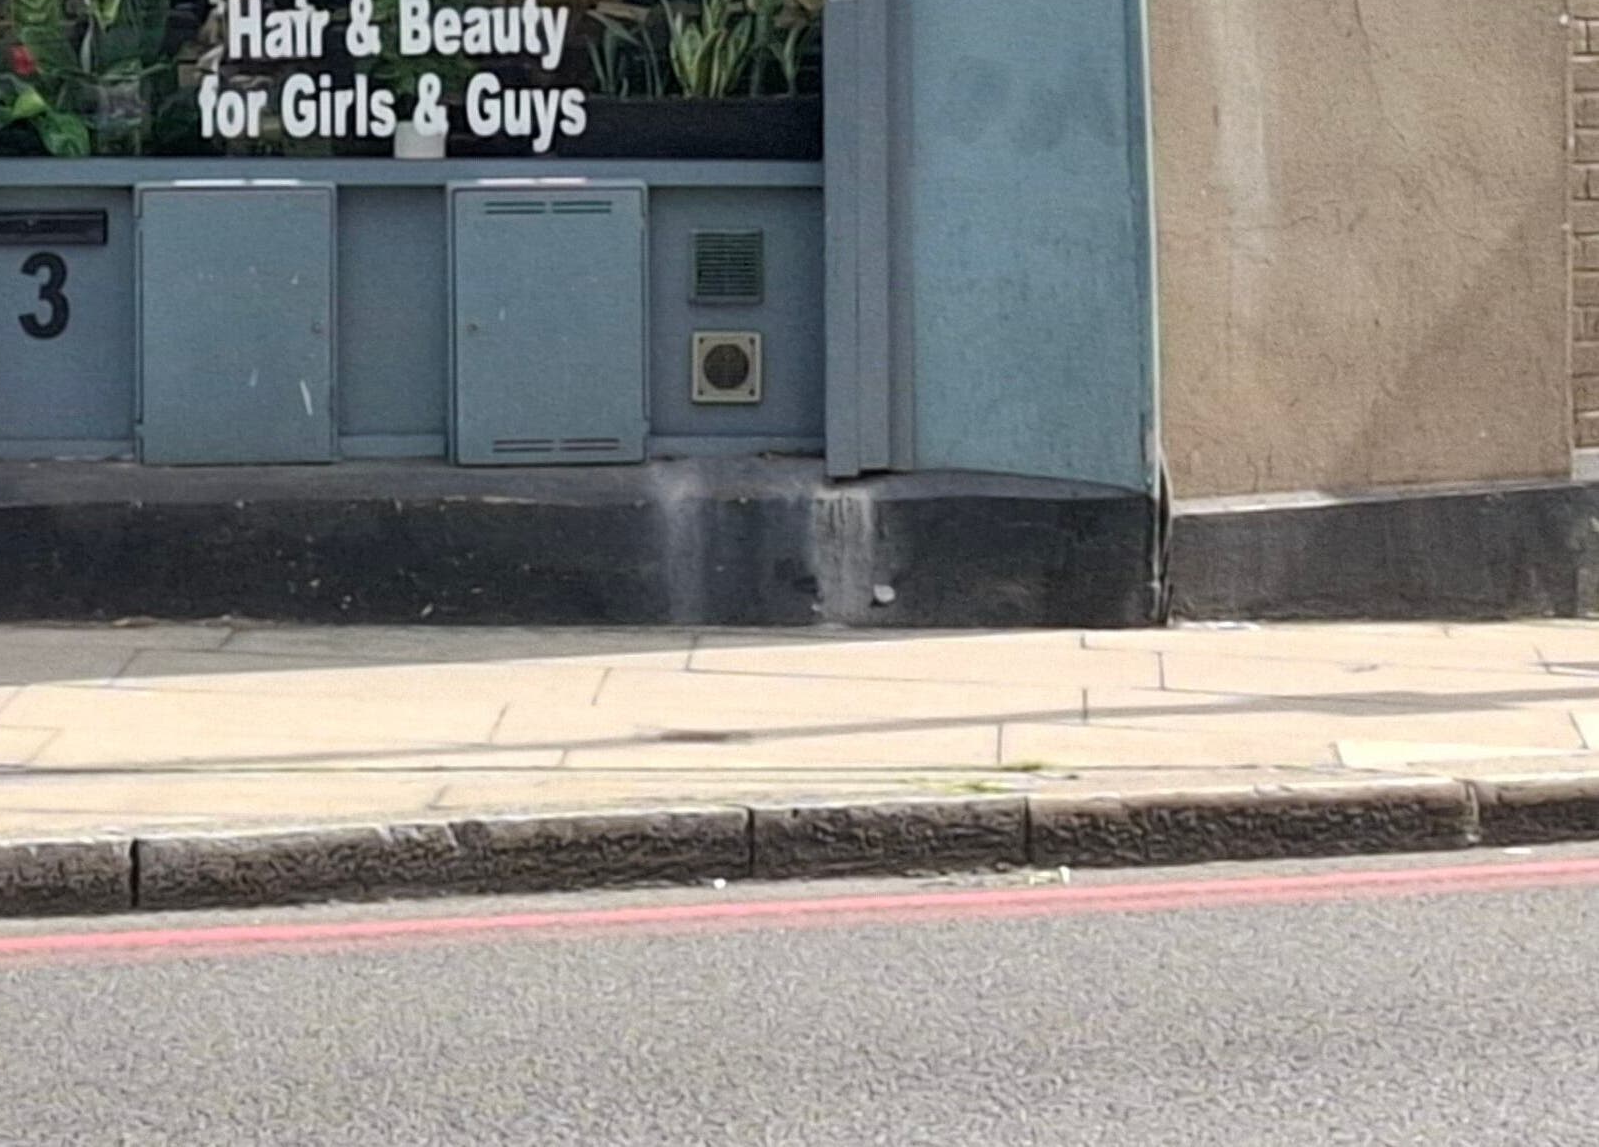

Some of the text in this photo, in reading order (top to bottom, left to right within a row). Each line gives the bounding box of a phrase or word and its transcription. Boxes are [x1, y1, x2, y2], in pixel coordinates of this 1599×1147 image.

[198, 72, 587, 153] for Girls & Guys
[18, 251, 70, 340] 3
